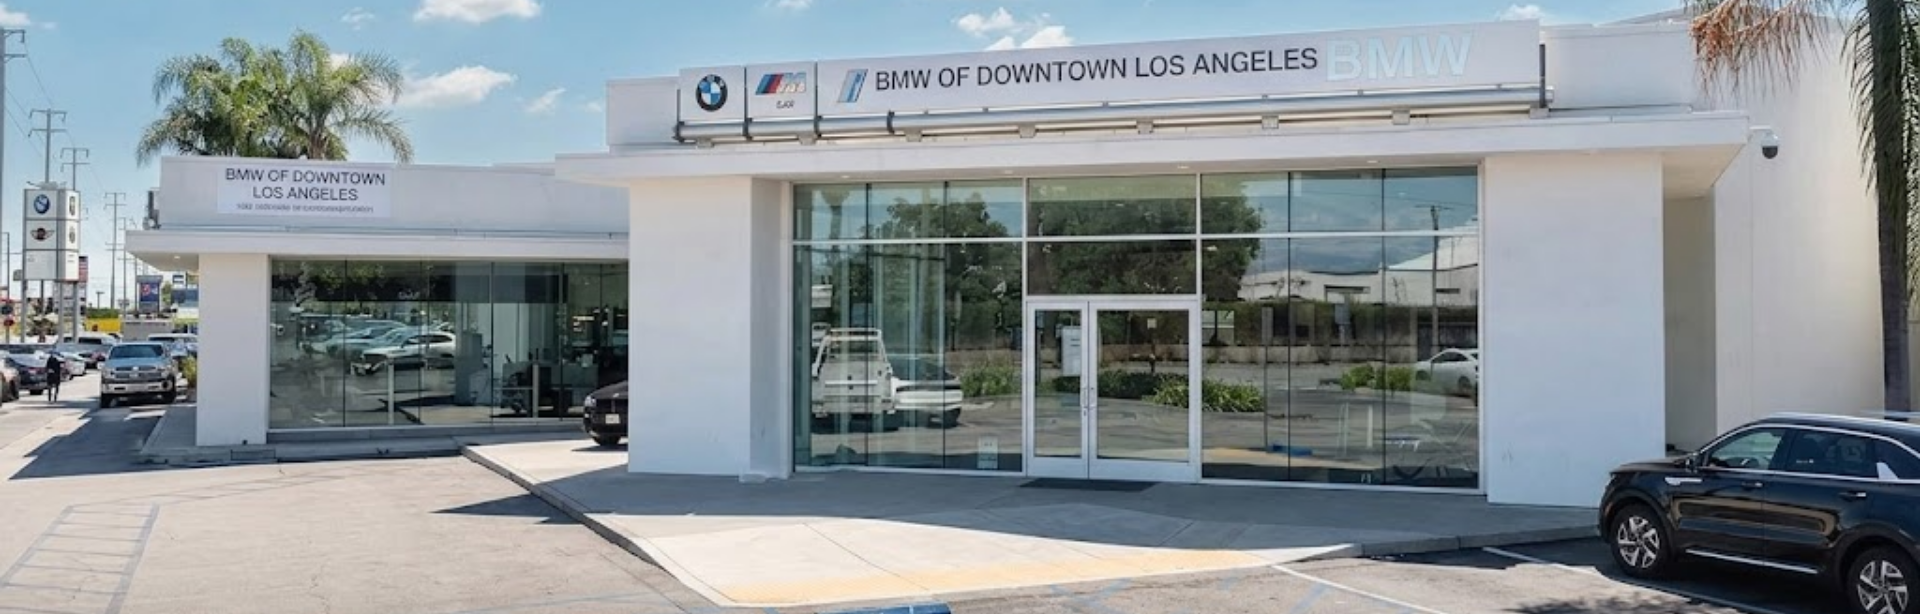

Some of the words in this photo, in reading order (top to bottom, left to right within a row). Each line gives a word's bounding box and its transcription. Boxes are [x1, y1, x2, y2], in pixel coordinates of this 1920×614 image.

[875, 68, 931, 91] BMW
[938, 65, 970, 87] OF
[977, 57, 1127, 86] DOWNTOWN
[1135, 54, 1184, 78] LOS
[1192, 47, 1318, 75] ANGELES
[1326, 34, 1472, 81] BMW
[225, 168, 265, 181] BMW
[267, 170, 289, 182] OF
[293, 170, 386, 185] DOWNTOWN
[252, 186, 284, 199] LOS
[286, 187, 359, 201] ANGELES
